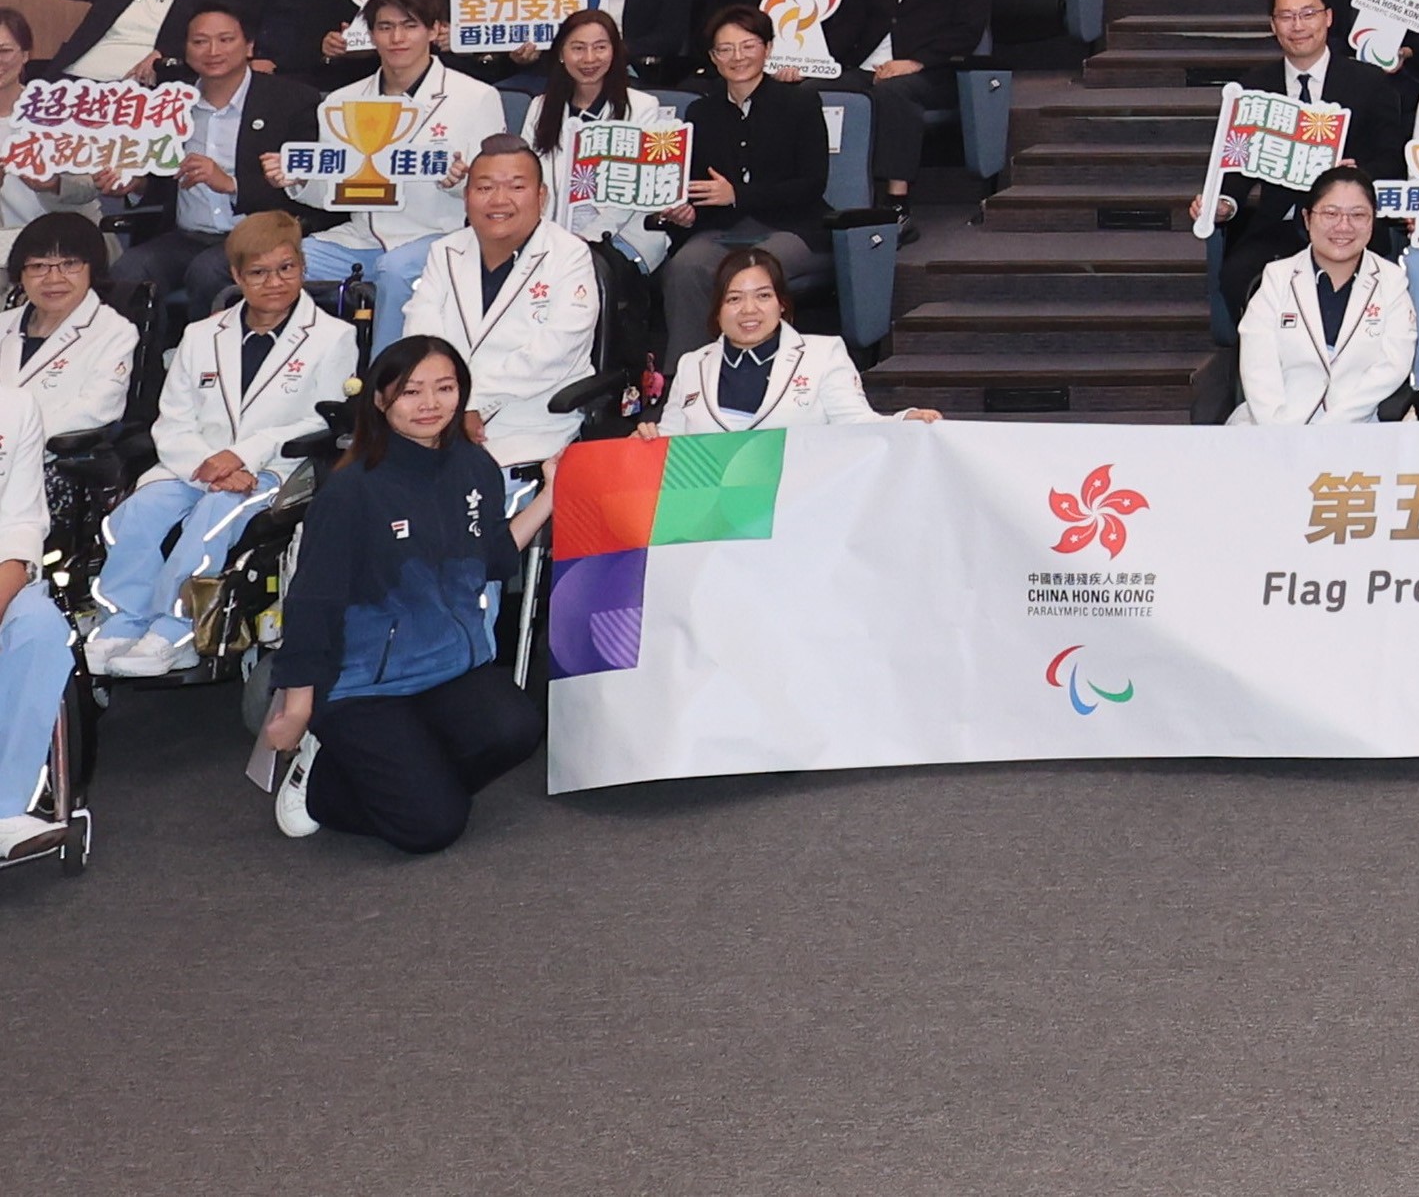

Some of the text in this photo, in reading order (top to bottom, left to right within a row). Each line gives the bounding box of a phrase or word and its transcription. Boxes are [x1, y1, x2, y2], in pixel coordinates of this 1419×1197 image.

[460, 23, 565, 46] 香港運動
[811, 65, 837, 75] 2026
[16, 85, 194, 136] 超越自我
[1234, 96, 1300, 133] 旗開
[1, 131, 181, 177] 成就非凡
[577, 125, 642, 161] 旗開
[1245, 133, 1334, 188] 得勝
[287, 148, 448, 175] 再創 佳績
[595, 160, 681, 206] 得勝
[1027, 588, 1155, 604] CHINA HONG KONG
[1261, 571, 1348, 613] Flag
[1027, 606, 1153, 617] PARALYMPIC COMMITTEE
